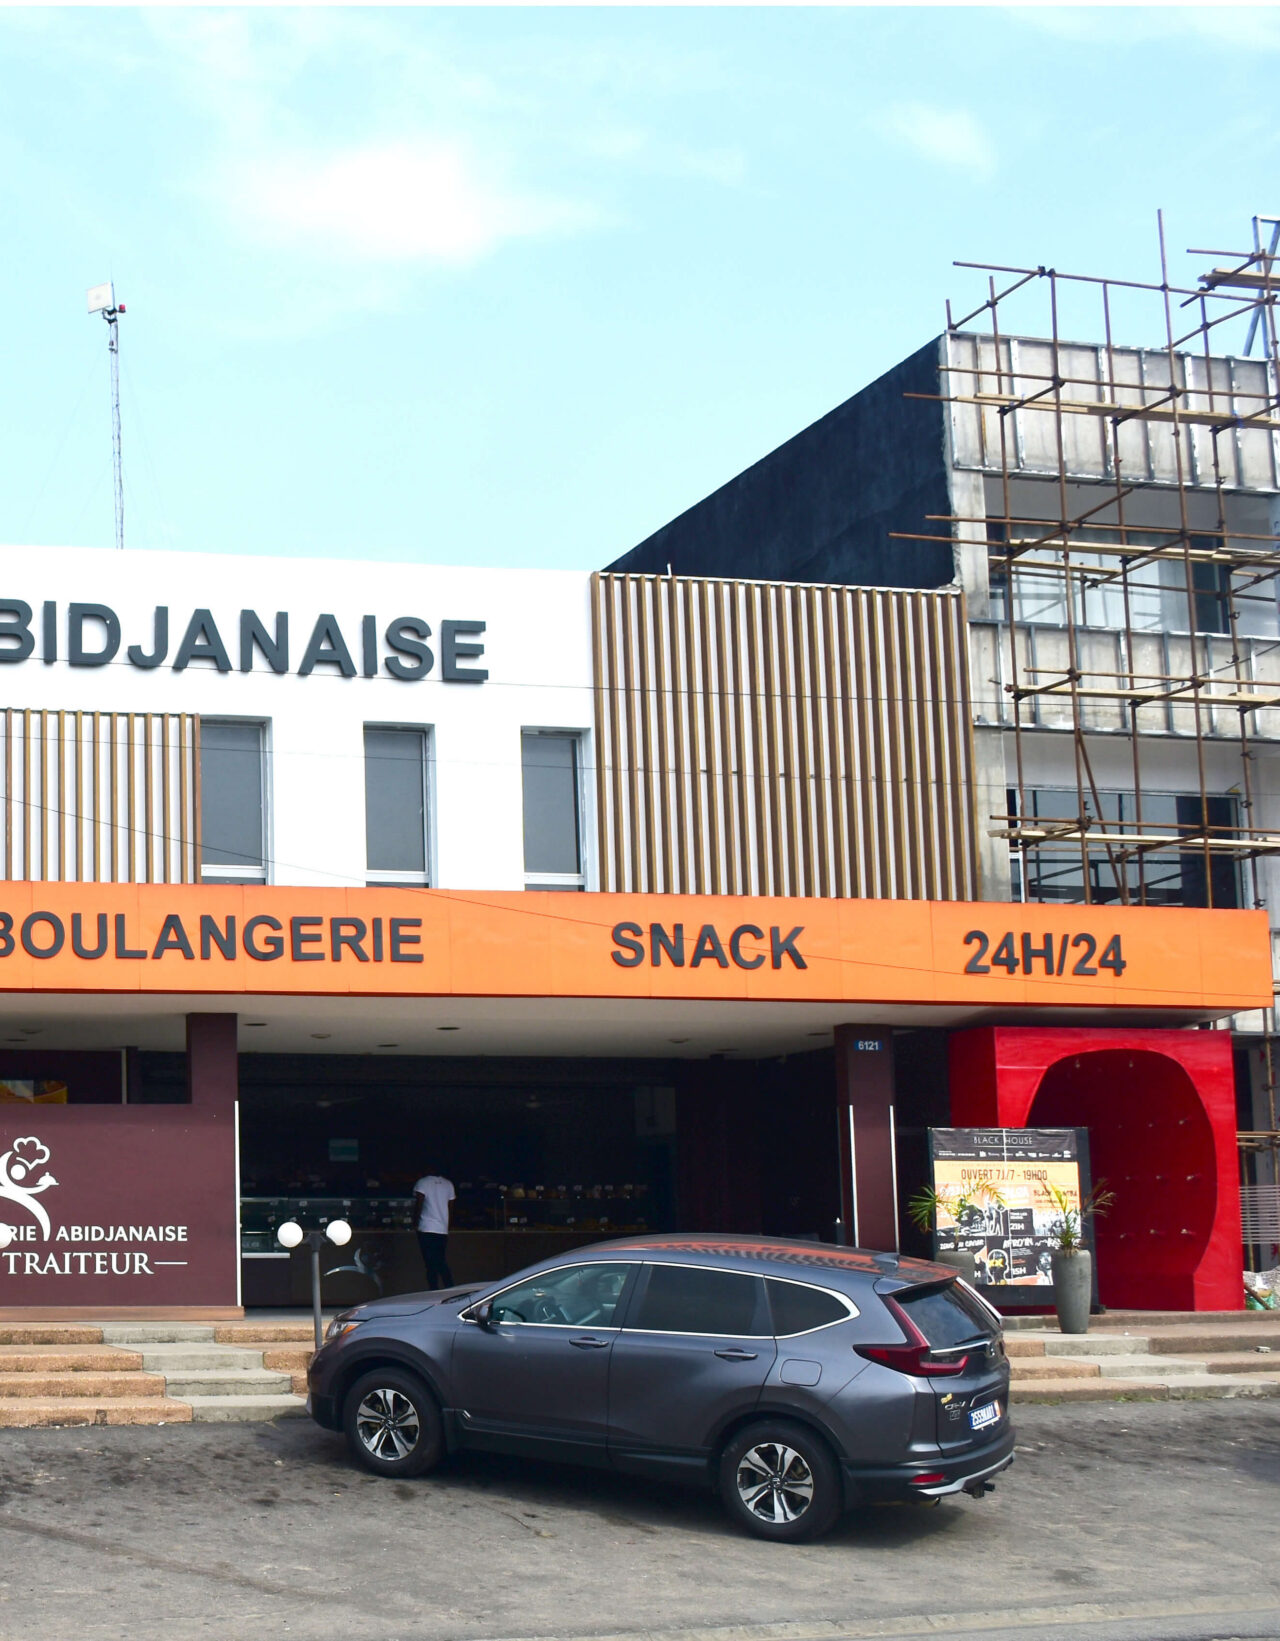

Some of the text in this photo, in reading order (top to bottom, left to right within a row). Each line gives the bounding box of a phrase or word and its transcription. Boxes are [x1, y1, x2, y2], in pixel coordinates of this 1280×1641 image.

[611, 921, 808, 971] SNACK
[964, 930, 1127, 978] 24H/24
[858, 1040, 879, 1051] 6121
[974, 1136, 1033, 1145] BLACK HOUSE
[961, 1169, 994, 1180] OUVERT
[56, 1225, 188, 1242] ABIDJANAISE
[1, 1252, 154, 1275] TRAITEUR
